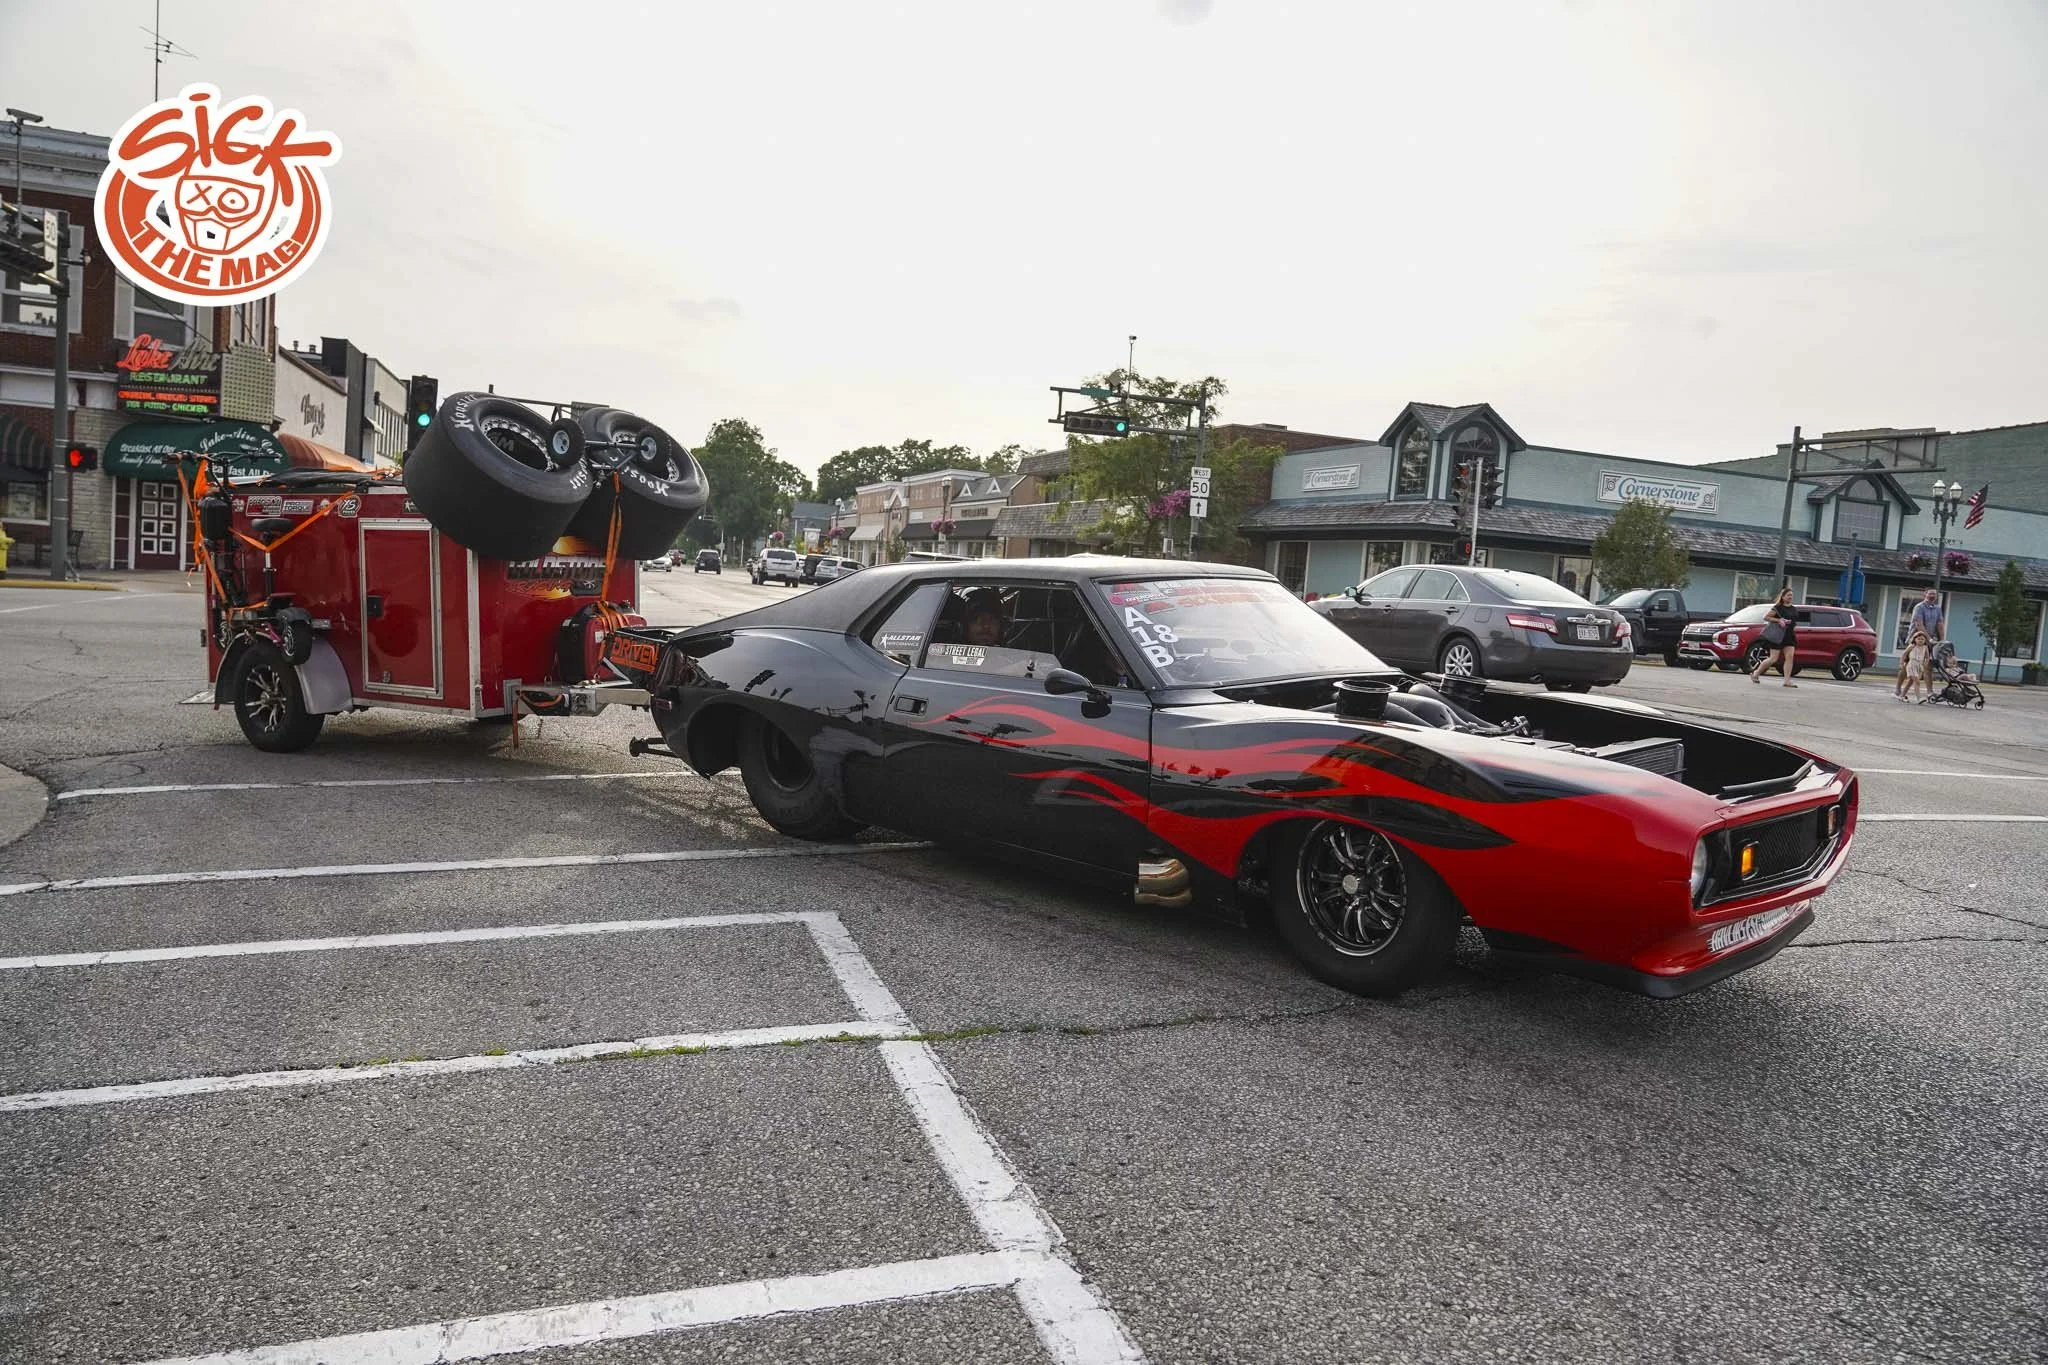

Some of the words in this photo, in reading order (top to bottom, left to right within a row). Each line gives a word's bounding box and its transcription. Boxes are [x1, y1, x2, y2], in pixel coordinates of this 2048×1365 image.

[116, 334, 173, 371] Lake
[129, 372, 209, 385] RESTAURANT
[1191, 481, 1208, 494] 50
[1618, 477, 1701, 502] Cornerstone
[1124, 606, 1153, 627] A
[612, 636, 660, 665] DRIVEN
[945, 645, 967, 656] STREET
[967, 647, 986, 657] LEGAL
[1143, 644, 1175, 668] B
